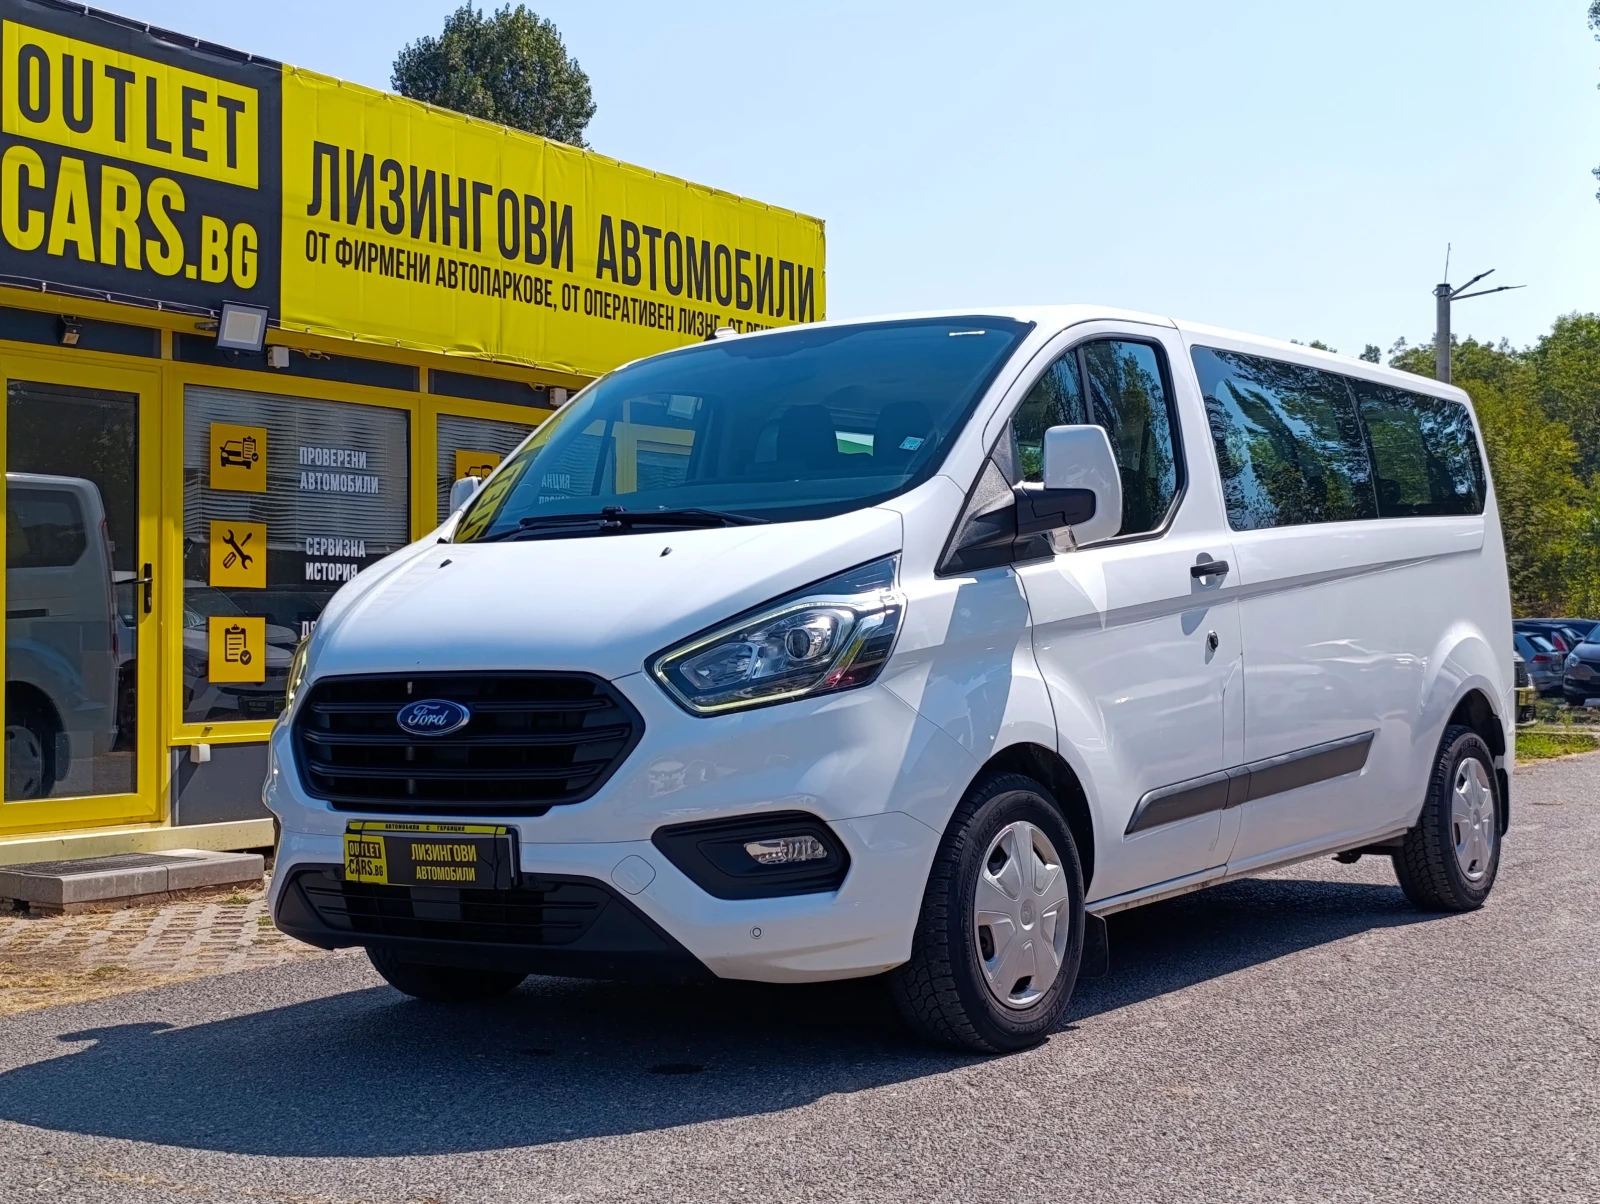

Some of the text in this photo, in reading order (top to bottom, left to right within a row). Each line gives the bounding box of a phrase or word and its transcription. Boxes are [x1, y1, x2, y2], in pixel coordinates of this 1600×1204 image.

[17, 43, 246, 170] OUTLET
[1, 145, 258, 290] CARS.BG
[306, 140, 815, 323] ЛИЗИНГОВИ АВТОМОБИЛИ
[305, 229, 330, 264] ОТ
[335, 236, 431, 284] ФИРМЕНИ
[435, 257, 557, 312] АВТОПАРКОВЕ,
[561, 283, 581, 313] ОТ
[584, 287, 674, 332] ОПЕРАТИВЕН
[299, 446, 367, 469] ПРОВЕРЕНИ
[300, 471, 379, 494] АВТОМОБИЛИ
[305, 537, 366, 558] СЕРВИЗНА
[407, 704, 449, 726] Ford
[348, 842, 380, 858] OUTLET
[411, 843, 477, 863] ЛИЗИНГОВИ
[349, 858, 384, 878] CARS.BG
[416, 865, 476, 882] АВТОМОБИЛИ
